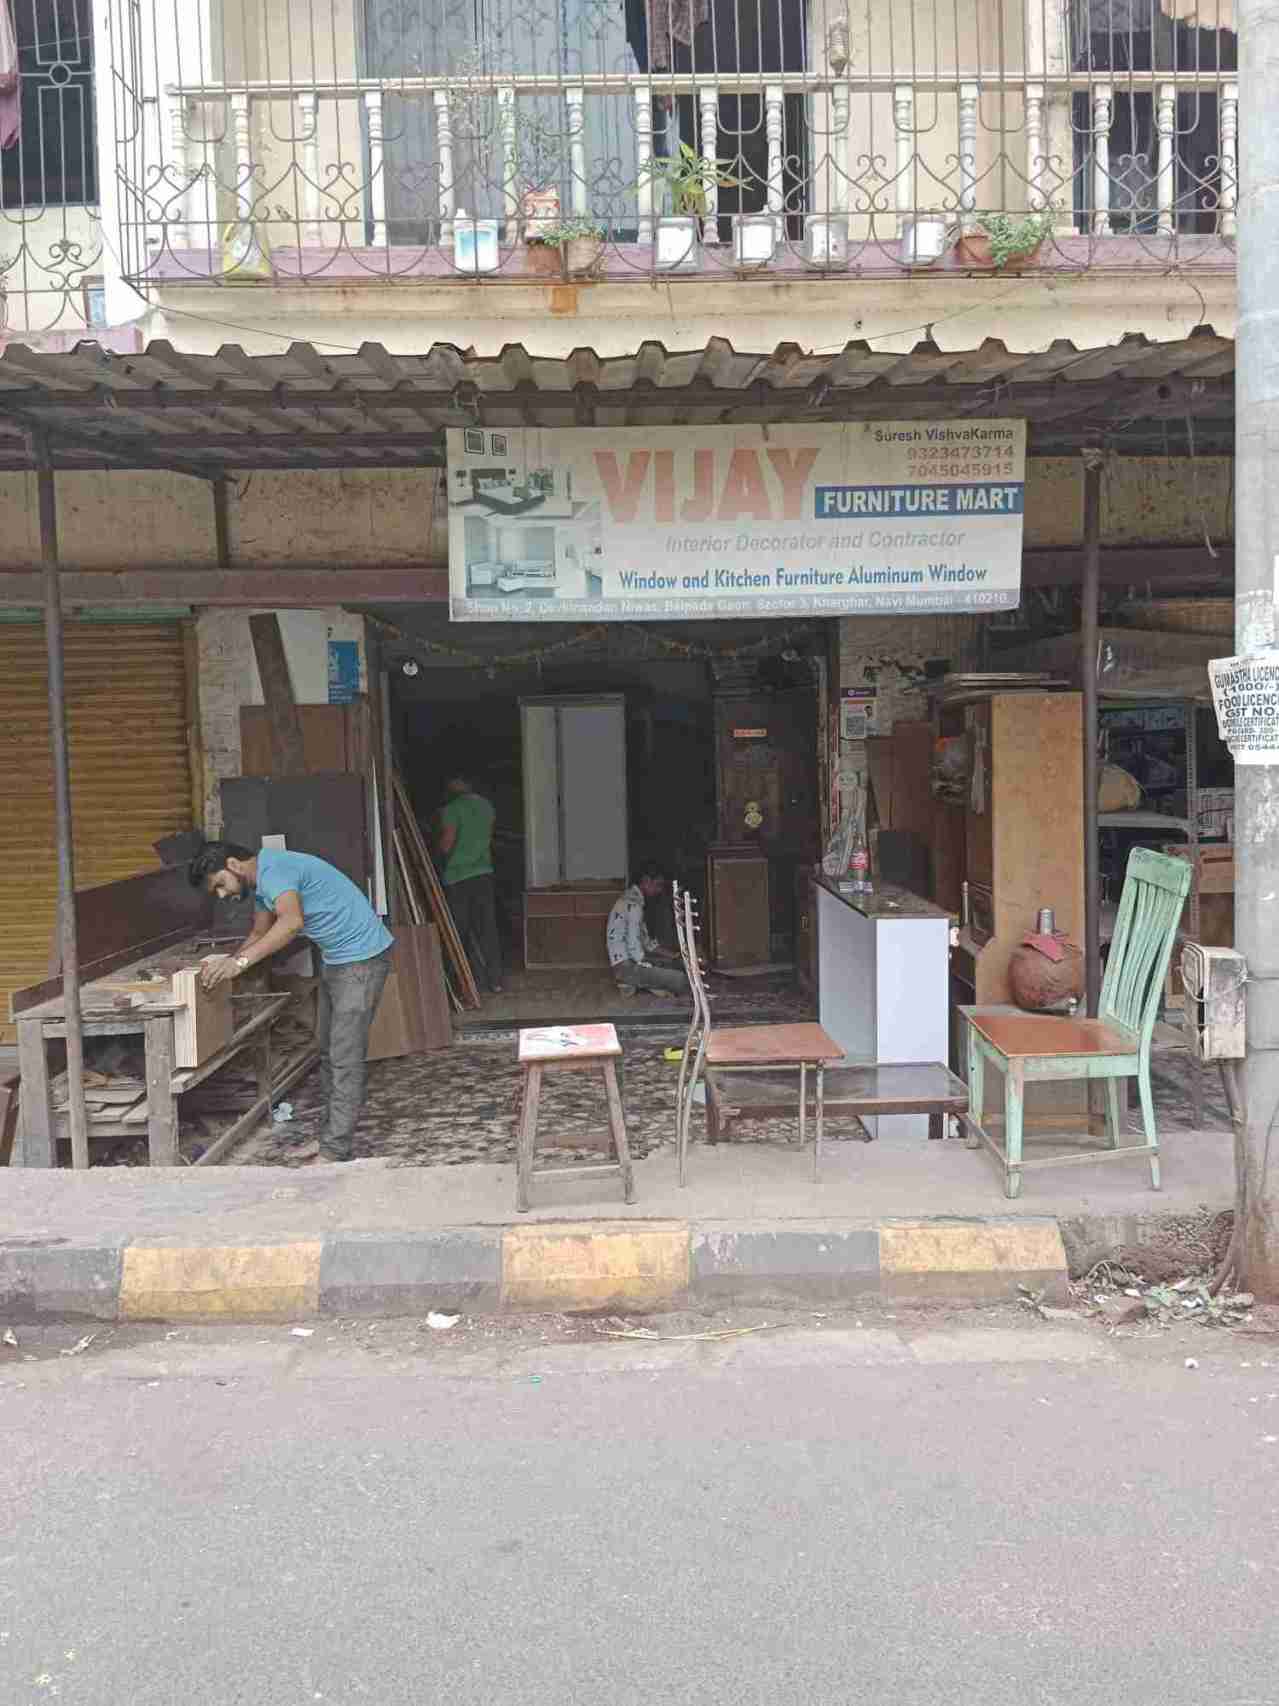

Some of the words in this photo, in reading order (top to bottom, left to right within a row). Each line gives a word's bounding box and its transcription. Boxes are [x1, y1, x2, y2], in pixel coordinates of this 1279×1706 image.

[875, 428, 922, 443] Suresh
[925, 427, 1014, 441] VishvaKarma
[591, 447, 821, 524] VIJAY
[823, 489, 949, 513] FURNITURE
[955, 487, 1018, 510] MART
[666, 535, 731, 553] Interior
[735, 532, 822, 551] Decorator
[831, 531, 863, 549] and
[868, 529, 966, 548] Contractor
[618, 570, 677, 589] Window
[682, 570, 709, 588] and
[714, 568, 770, 587] Kitchen
[776, 567, 843, 586] Furniture
[848, 565, 923, 584] Aluminum
[928, 563, 988, 582] Window
[1225, 707, 1248, 718] GST
